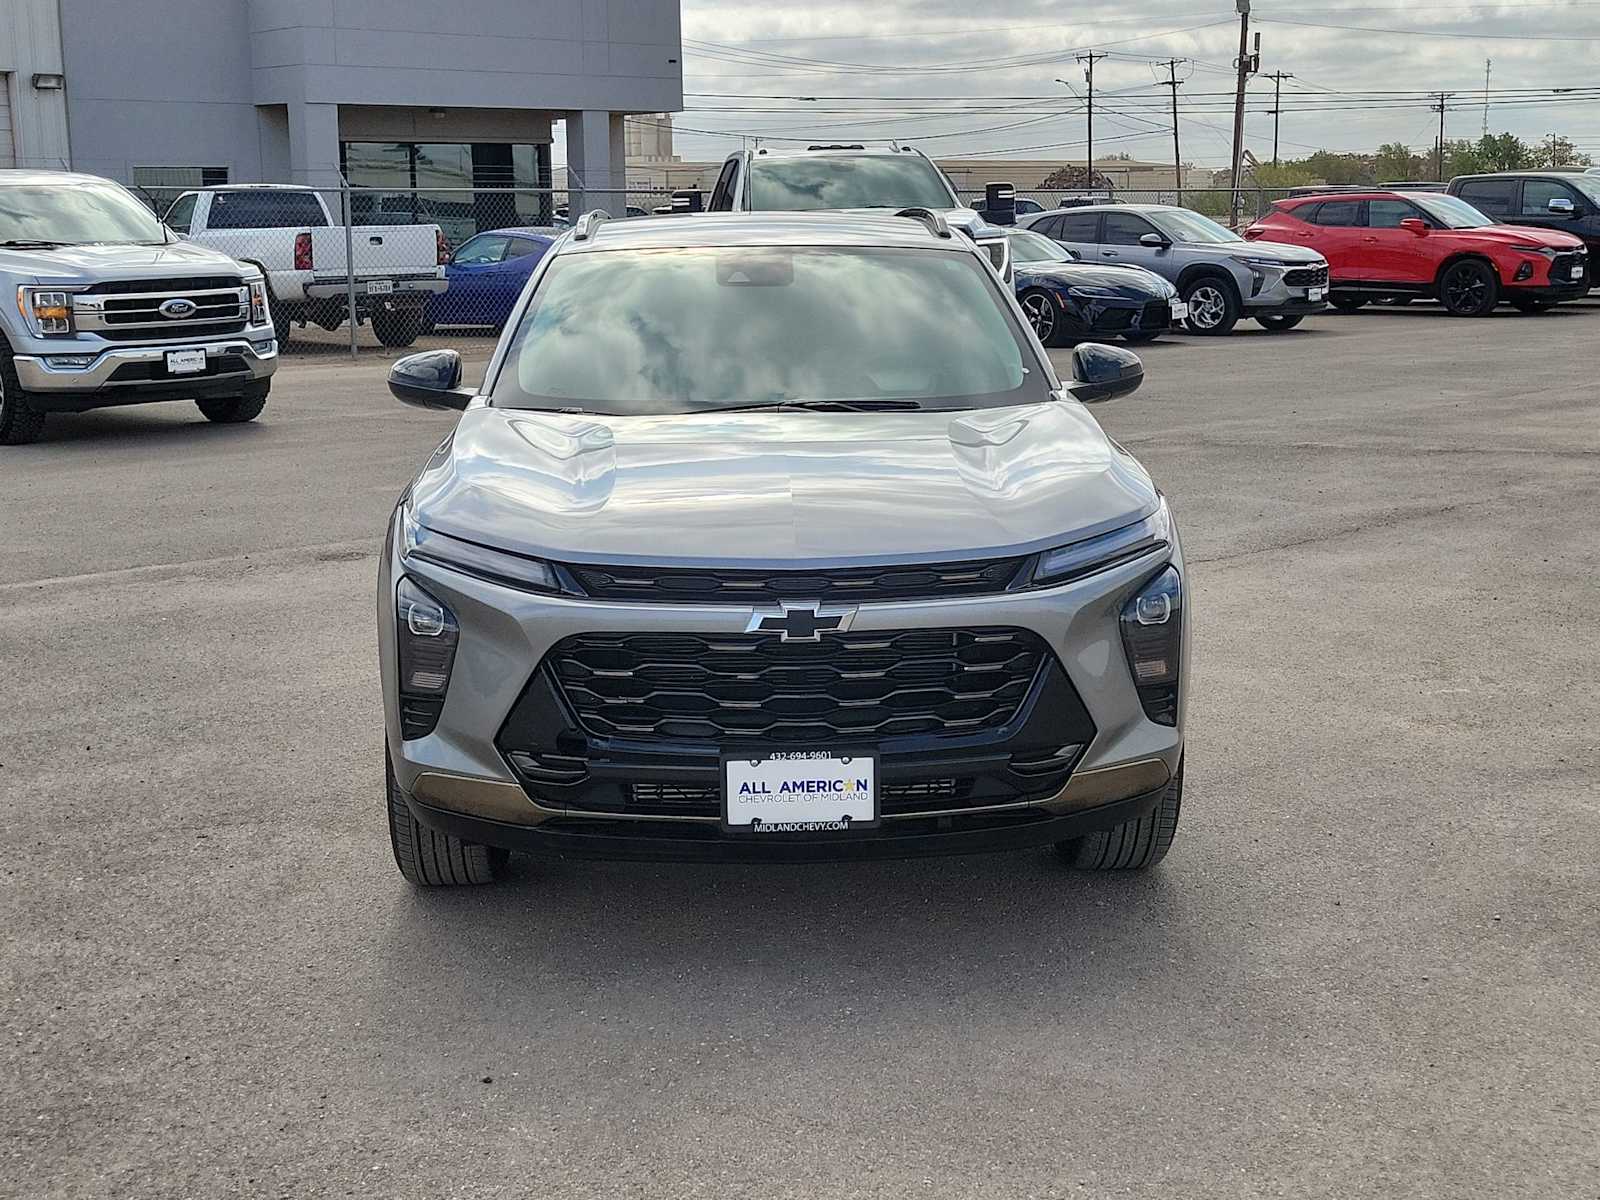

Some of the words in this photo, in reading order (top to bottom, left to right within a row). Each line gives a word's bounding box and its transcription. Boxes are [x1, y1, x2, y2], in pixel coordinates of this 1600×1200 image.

[170, 303, 188, 312] Ford
[769, 751, 832, 761] 432-694-9601
[739, 781, 771, 794] ALL
[738, 793, 801, 804] CHEVROLET
[803, 793, 819, 802] OF
[820, 792, 868, 801] MIDLAND
[754, 820, 849, 833] MIDLANDCHEVY.COM
